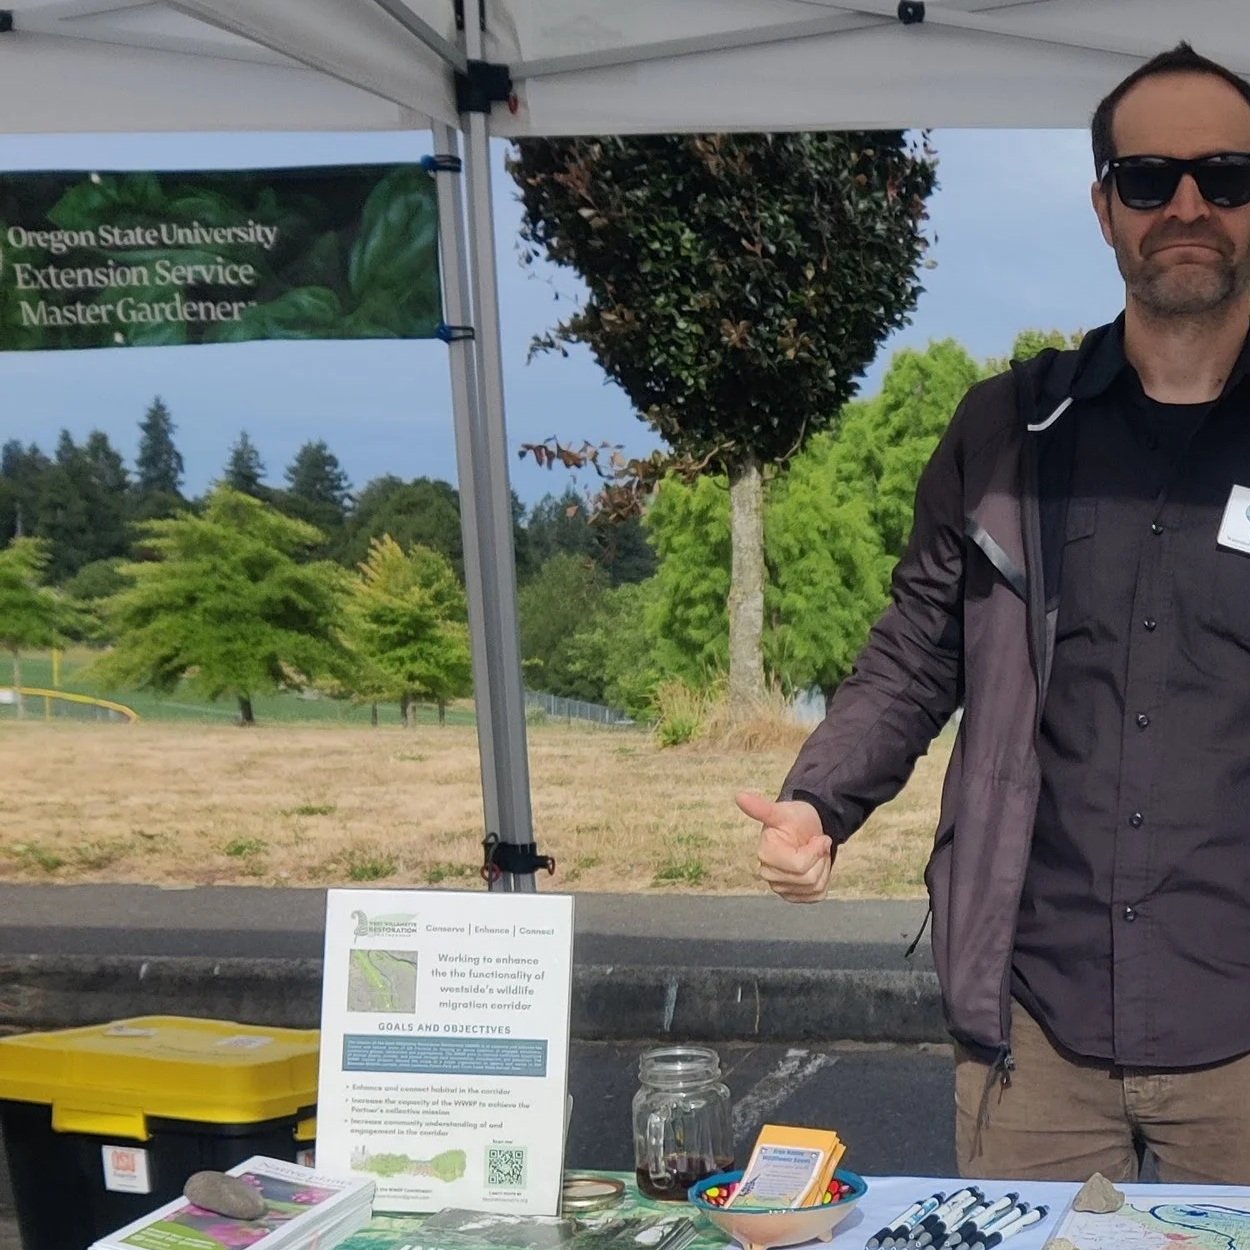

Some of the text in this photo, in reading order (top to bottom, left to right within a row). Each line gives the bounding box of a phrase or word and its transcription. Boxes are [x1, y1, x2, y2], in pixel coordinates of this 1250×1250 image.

[8, 219, 278, 255] Oregon State University
[14, 256, 256, 290] Extension Service
[20, 298, 114, 327] Master
[475, 926, 509, 934] Enhance
[519, 927, 554, 936] Connect
[438, 954, 480, 965] Working
[496, 956, 539, 965] enhance
[432, 969, 545, 982] the the functionality of
[497, 986, 534, 996] wildlife
[439, 1001, 532, 1011] migration corridor
[379, 1023, 511, 1034] GOALS AND OBJECTIVES
